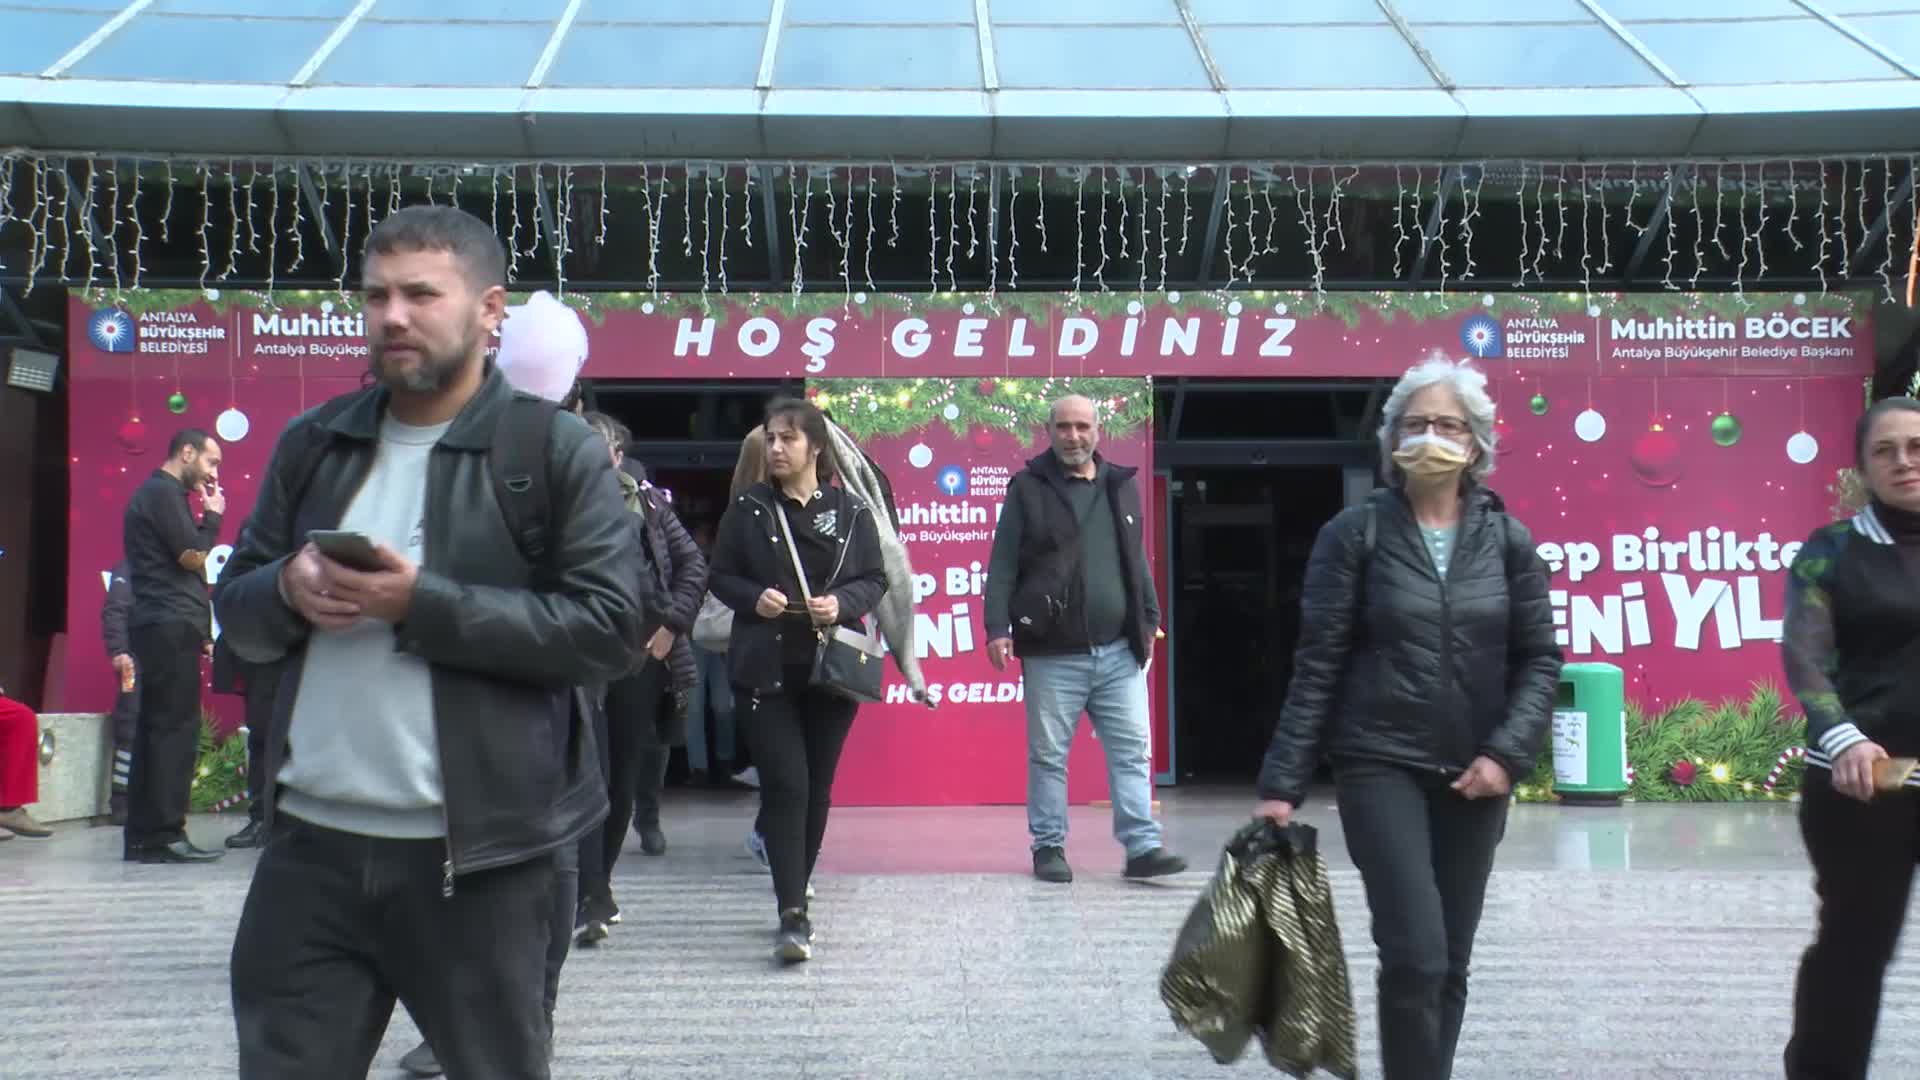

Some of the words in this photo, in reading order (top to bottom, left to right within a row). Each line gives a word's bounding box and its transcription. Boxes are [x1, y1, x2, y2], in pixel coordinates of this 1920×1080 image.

[139, 312, 197, 323] ANTALYA
[252, 312, 368, 337] Muhitti
[1506, 318, 1559, 329] ANTALYA
[139, 325, 225, 341] BÜYÜKŞEHİR
[1611, 315, 1736, 340] Muhittin
[1745, 311, 1852, 339] BÖCEK
[673, 317, 837, 373] HOŞ
[1506, 330, 1586, 346] BÜYÜKŞEHİR
[139, 340, 208, 354] BELEDİYESİ
[254, 343, 306, 358] Antalya
[310, 343, 368, 358] Büyükşe
[1506, 345, 1569, 359] BELEDİYESİ
[1612, 346, 1662, 360] Antalya
[1665, 346, 1738, 361] Büyükşehir
[1741, 346, 1798, 360] Belediye
[1801, 346, 1854, 360] Başkanı
[970, 466, 1009, 475] ANTALYA
[970, 475, 1011, 487] BÜYÜKŞ
[895, 500, 987, 525] uhittin
[919, 529, 989, 544] Büyükşehir
[1536, 541, 1601, 582] ep
[1661, 572, 1784, 650] YIL
[947, 675, 1024, 703] GELDİ
